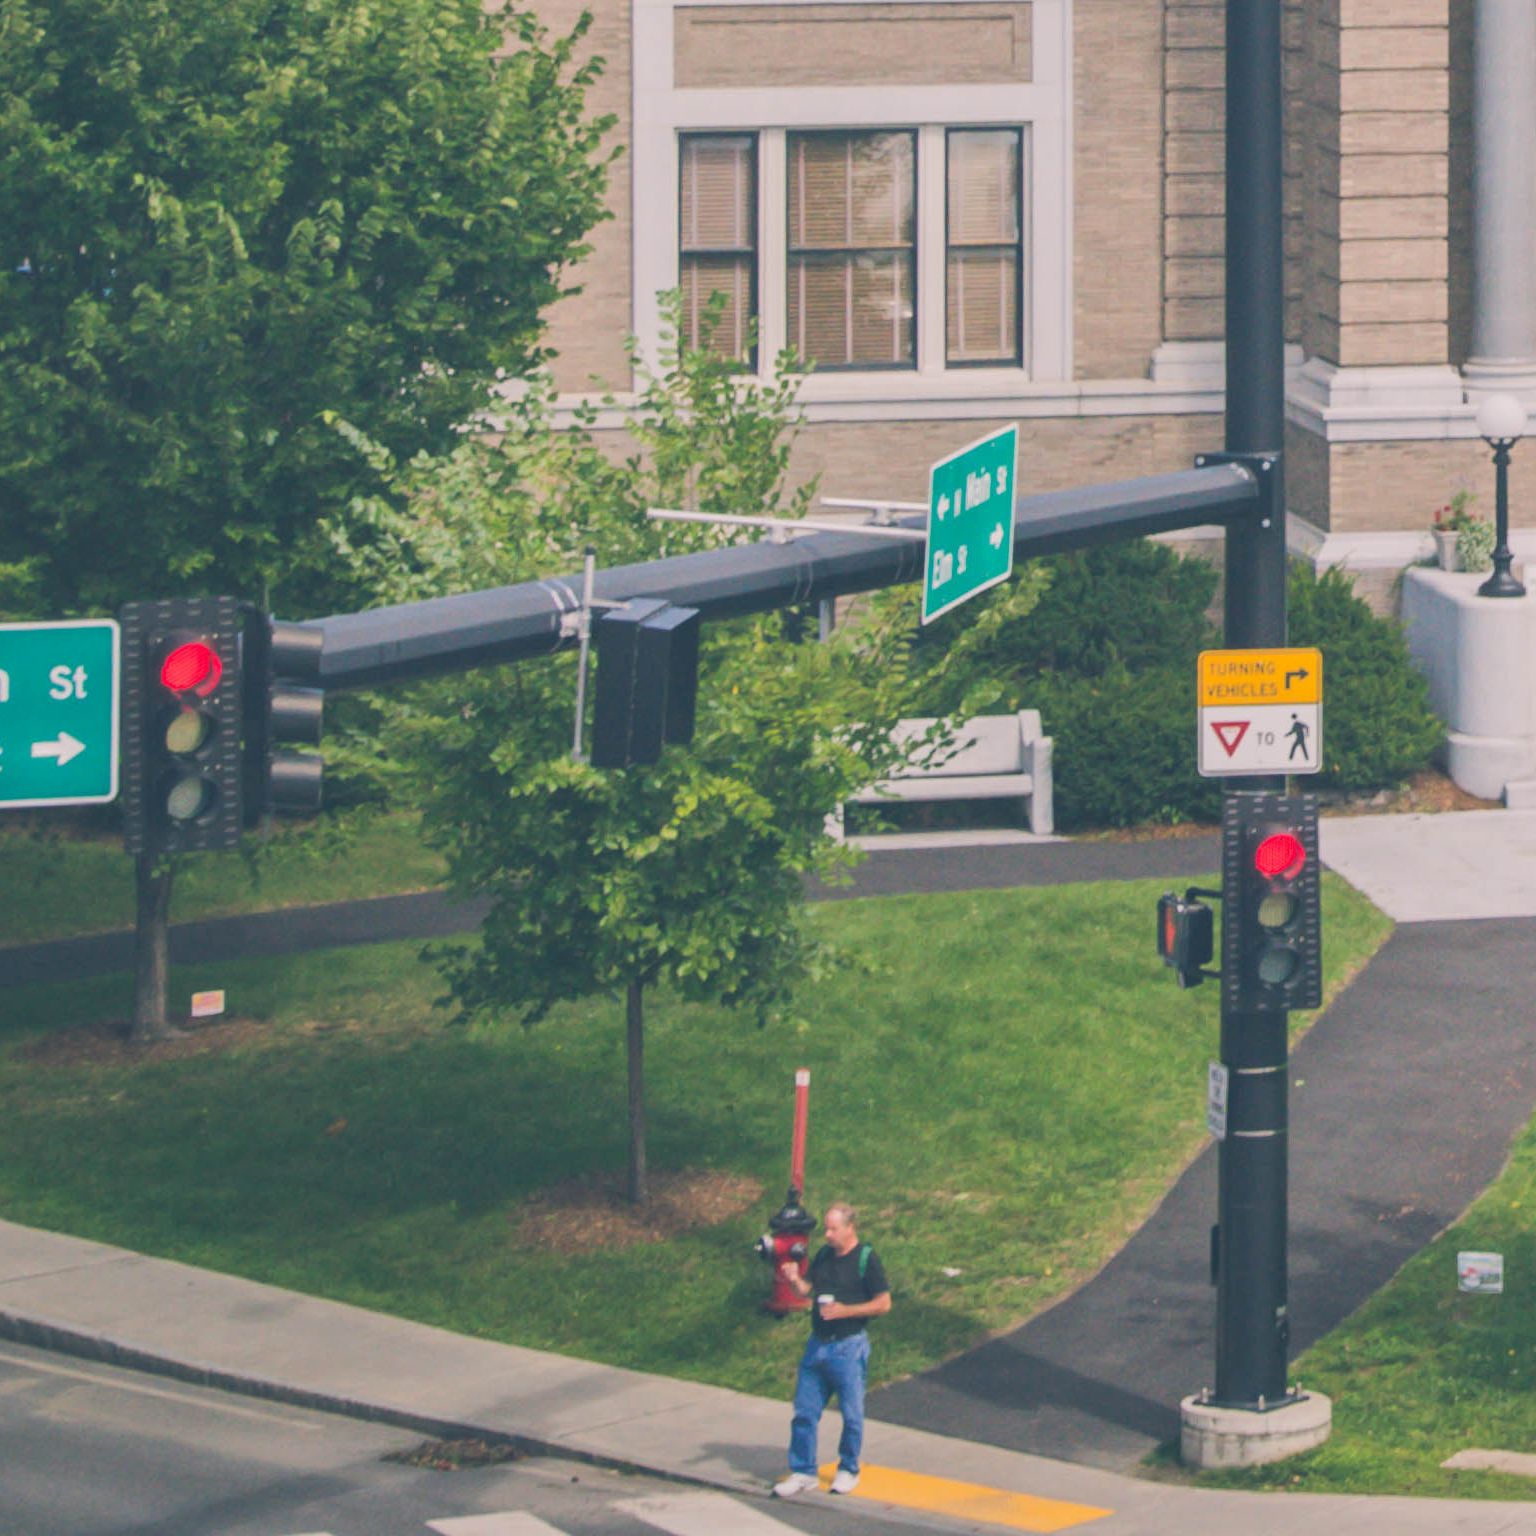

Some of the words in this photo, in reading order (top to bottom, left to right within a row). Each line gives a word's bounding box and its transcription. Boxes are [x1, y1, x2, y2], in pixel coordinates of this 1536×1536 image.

[965, 467, 991, 512] Main
[931, 549, 953, 590] Elm
[1210, 661, 1276, 677] TURNING
[49, 665, 88, 700] St
[1207, 683, 1278, 698] VEHICLES
[1257, 732, 1275, 746] TO
